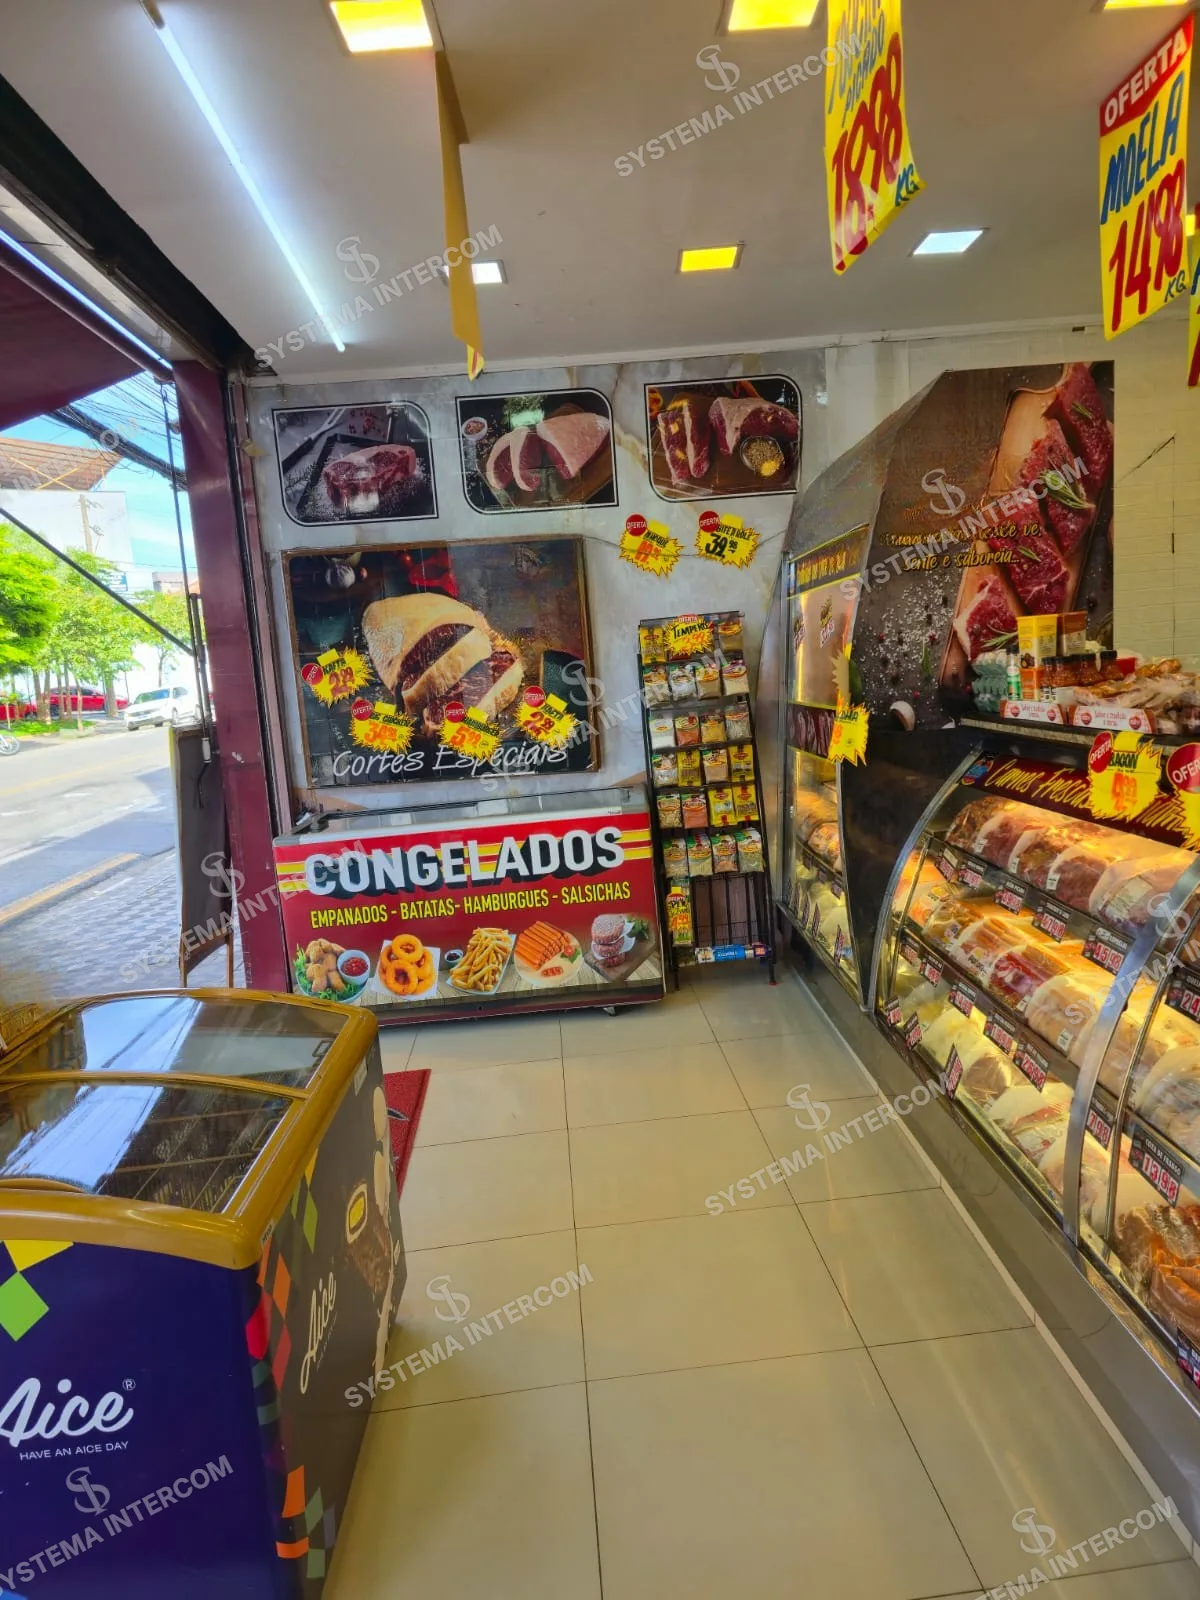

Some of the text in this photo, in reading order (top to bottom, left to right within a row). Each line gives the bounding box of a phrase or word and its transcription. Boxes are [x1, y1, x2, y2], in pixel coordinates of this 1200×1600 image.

[1104, 27, 1187, 127] OFERTA
[1100, 71, 1184, 225] MOELA
[895, 163, 919, 206] KG
[1165, 271, 1187, 302] KG
[626, 521, 648, 529] OFERTA
[700, 516, 720, 527] OFERTA
[943, 554, 951, 567] e
[678, 616, 698, 624] OFERTA
[352, 705, 373, 716] OFERTA
[333, 741, 567, 778] Cortes Especiais
[1090, 740, 1111, 764] OFERTA
[1109, 753, 1138, 769] BACON
[984, 759, 1044, 797] Carnes
[305, 826, 626, 896] CONGELADOS
[311, 903, 388, 929] EMPANADOS
[400, 898, 454, 920] BATATAS
[464, 889, 549, 915] HAMBURGUES
[561, 881, 631, 904] SALSICHAS
[300, 1271, 337, 1395] Aice
[0, 1377, 134, 1448] Aice
[20, 1441, 129, 1460] HAVE AN AICE DAY
